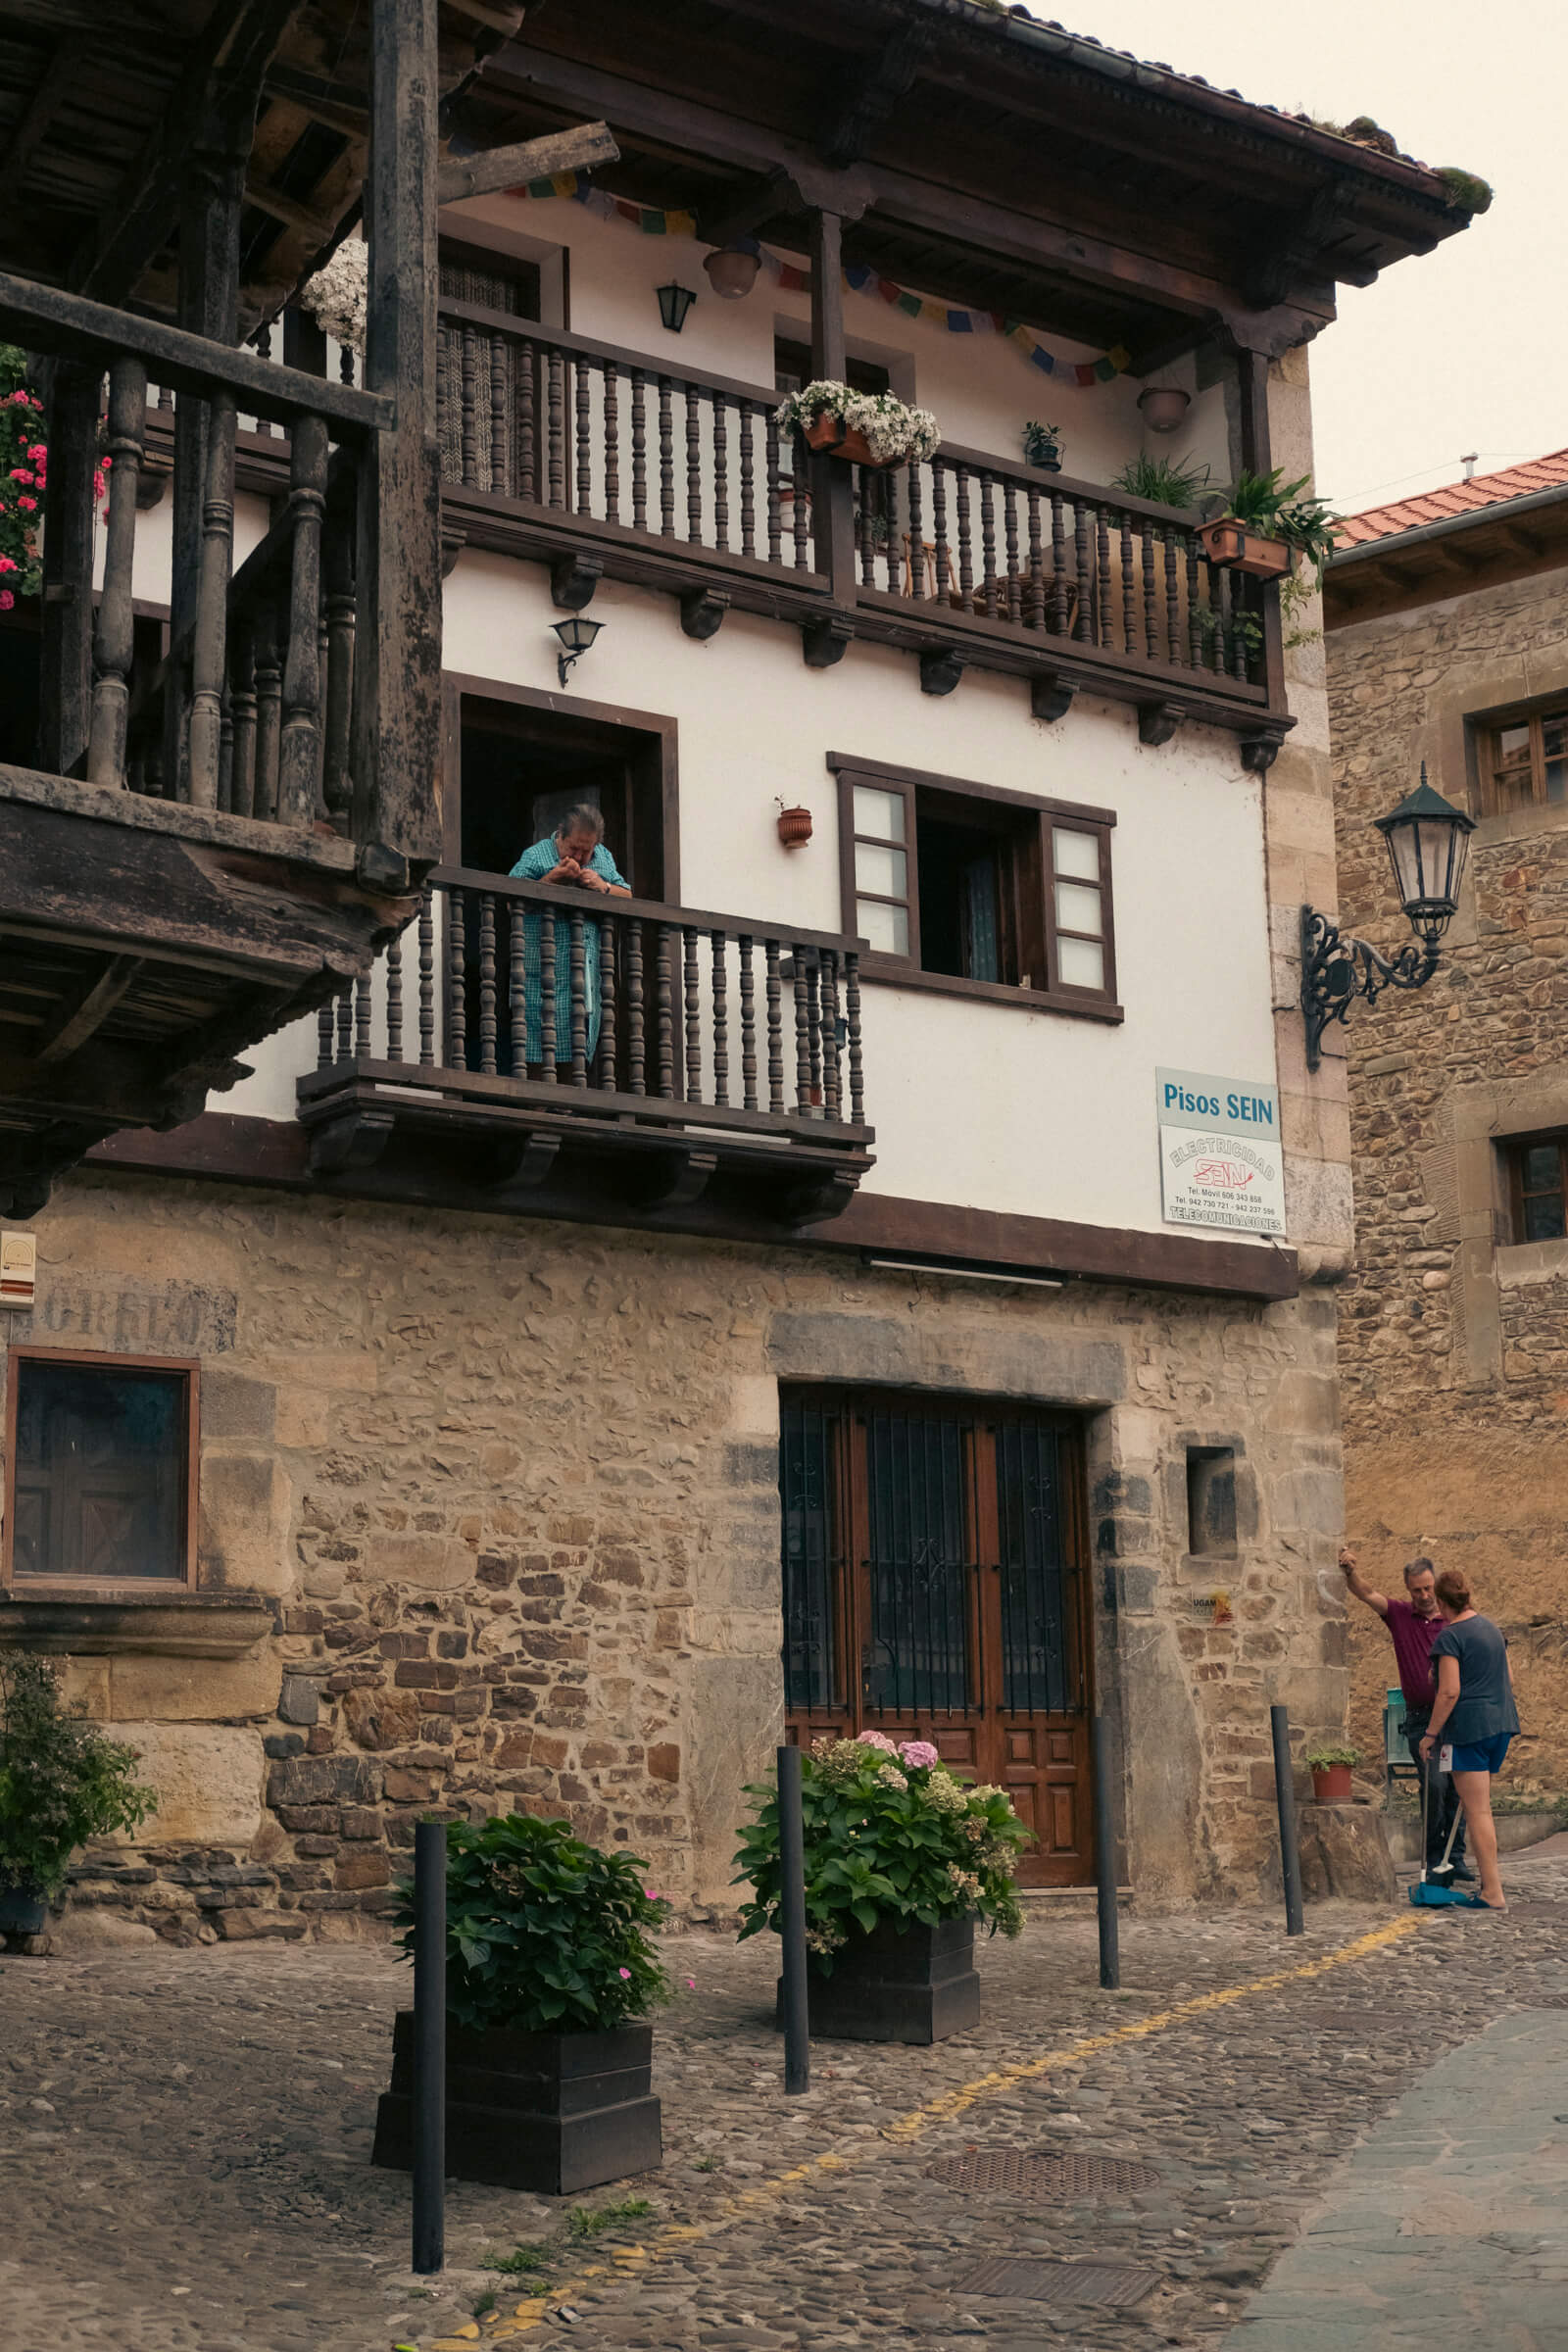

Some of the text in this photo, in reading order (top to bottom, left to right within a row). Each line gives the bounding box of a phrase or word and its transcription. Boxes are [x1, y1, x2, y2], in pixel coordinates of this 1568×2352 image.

[1164, 1083, 1273, 1125] Pisos SEIN
[1169, 1138, 1275, 1181] ELECTRICIDAD
[1195, 1158, 1250, 1190] SEIN
[1188, 1187, 1200, 1196] Tel.
[1222, 1191, 1234, 1200] 606
[1236, 1193, 1248, 1201] 343
[1189, 1198, 1201, 1206] 942
[1203, 1200, 1215, 1208] 730
[1236, 1203, 1248, 1212] 942
[1170, 1206, 1282, 1231] TELECOMUNICACIONES
